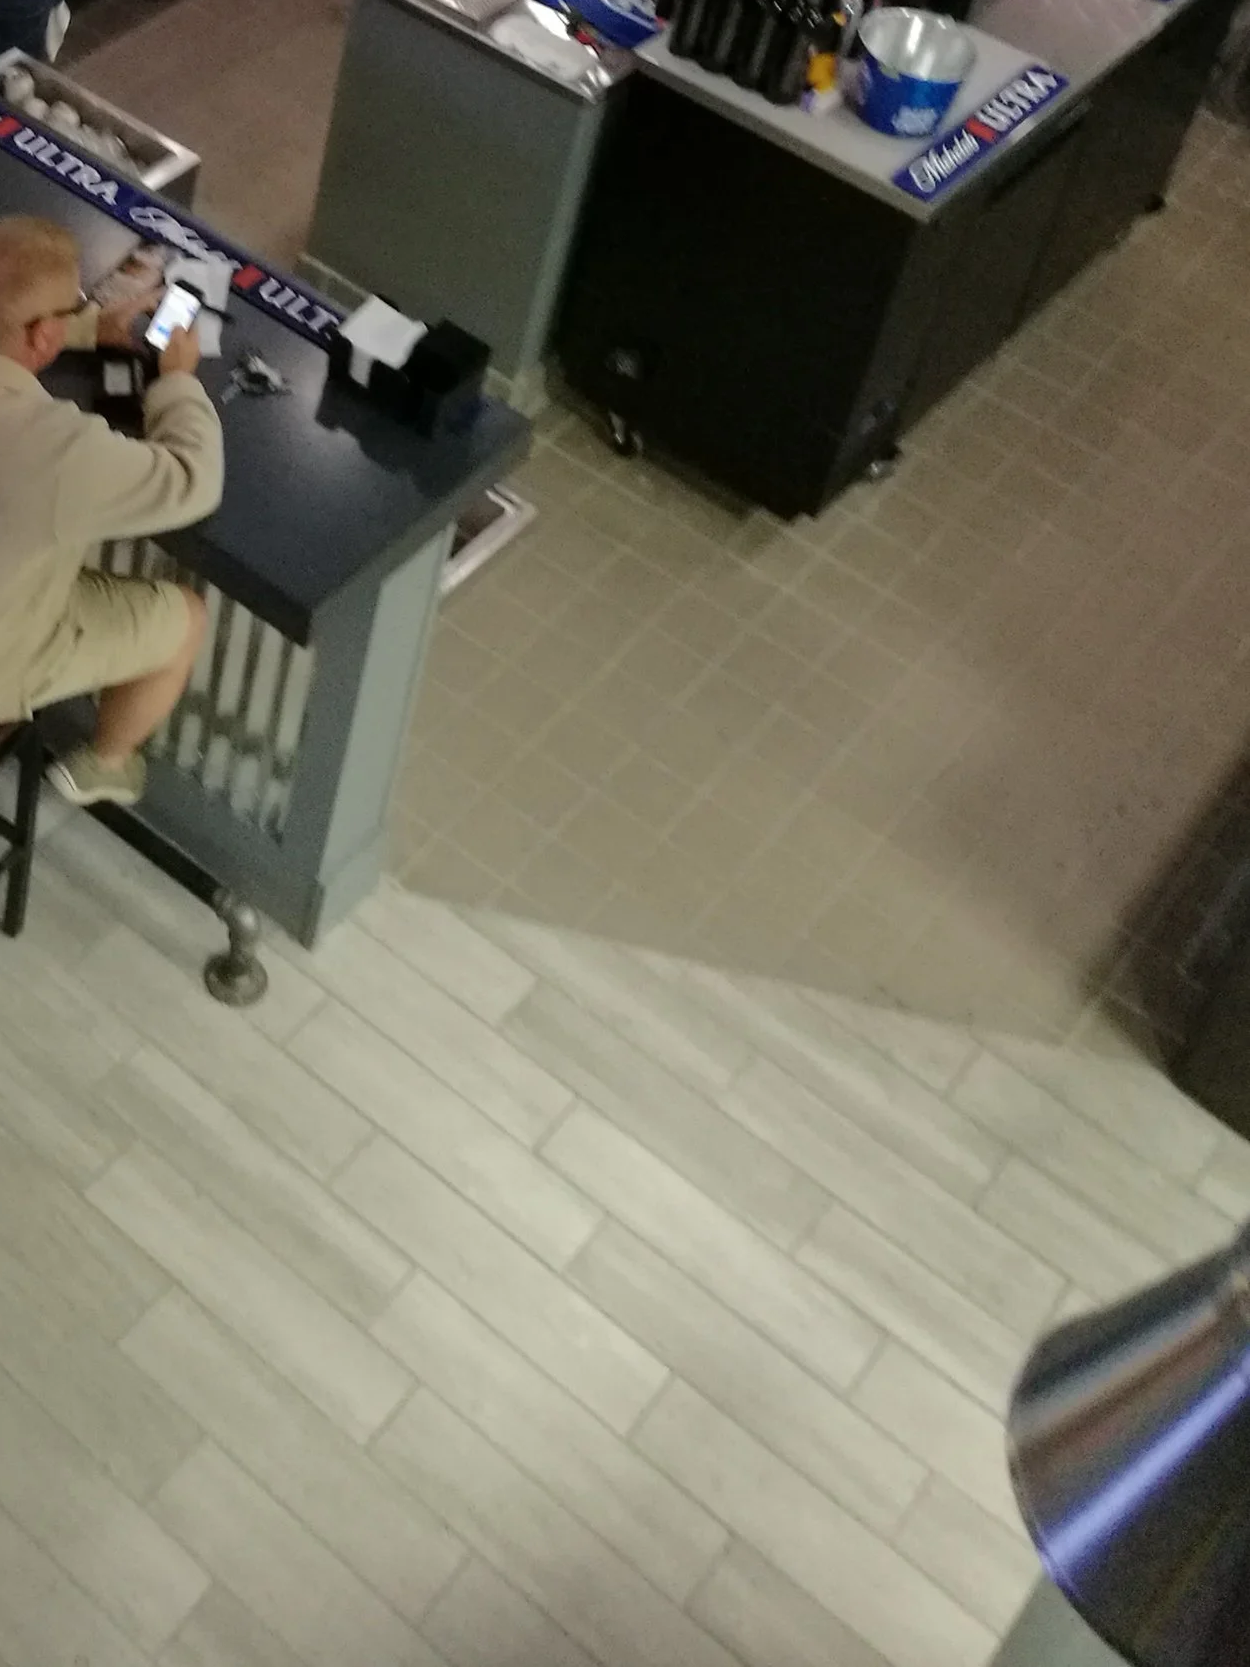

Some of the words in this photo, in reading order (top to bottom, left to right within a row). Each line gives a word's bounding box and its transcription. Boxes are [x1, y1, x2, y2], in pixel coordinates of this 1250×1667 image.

[13, 127, 119, 206] ULTRA
[907, 128, 981, 194] Michelob
[973, 69, 1059, 134] ULTRA
[258, 277, 340, 342] ULT
